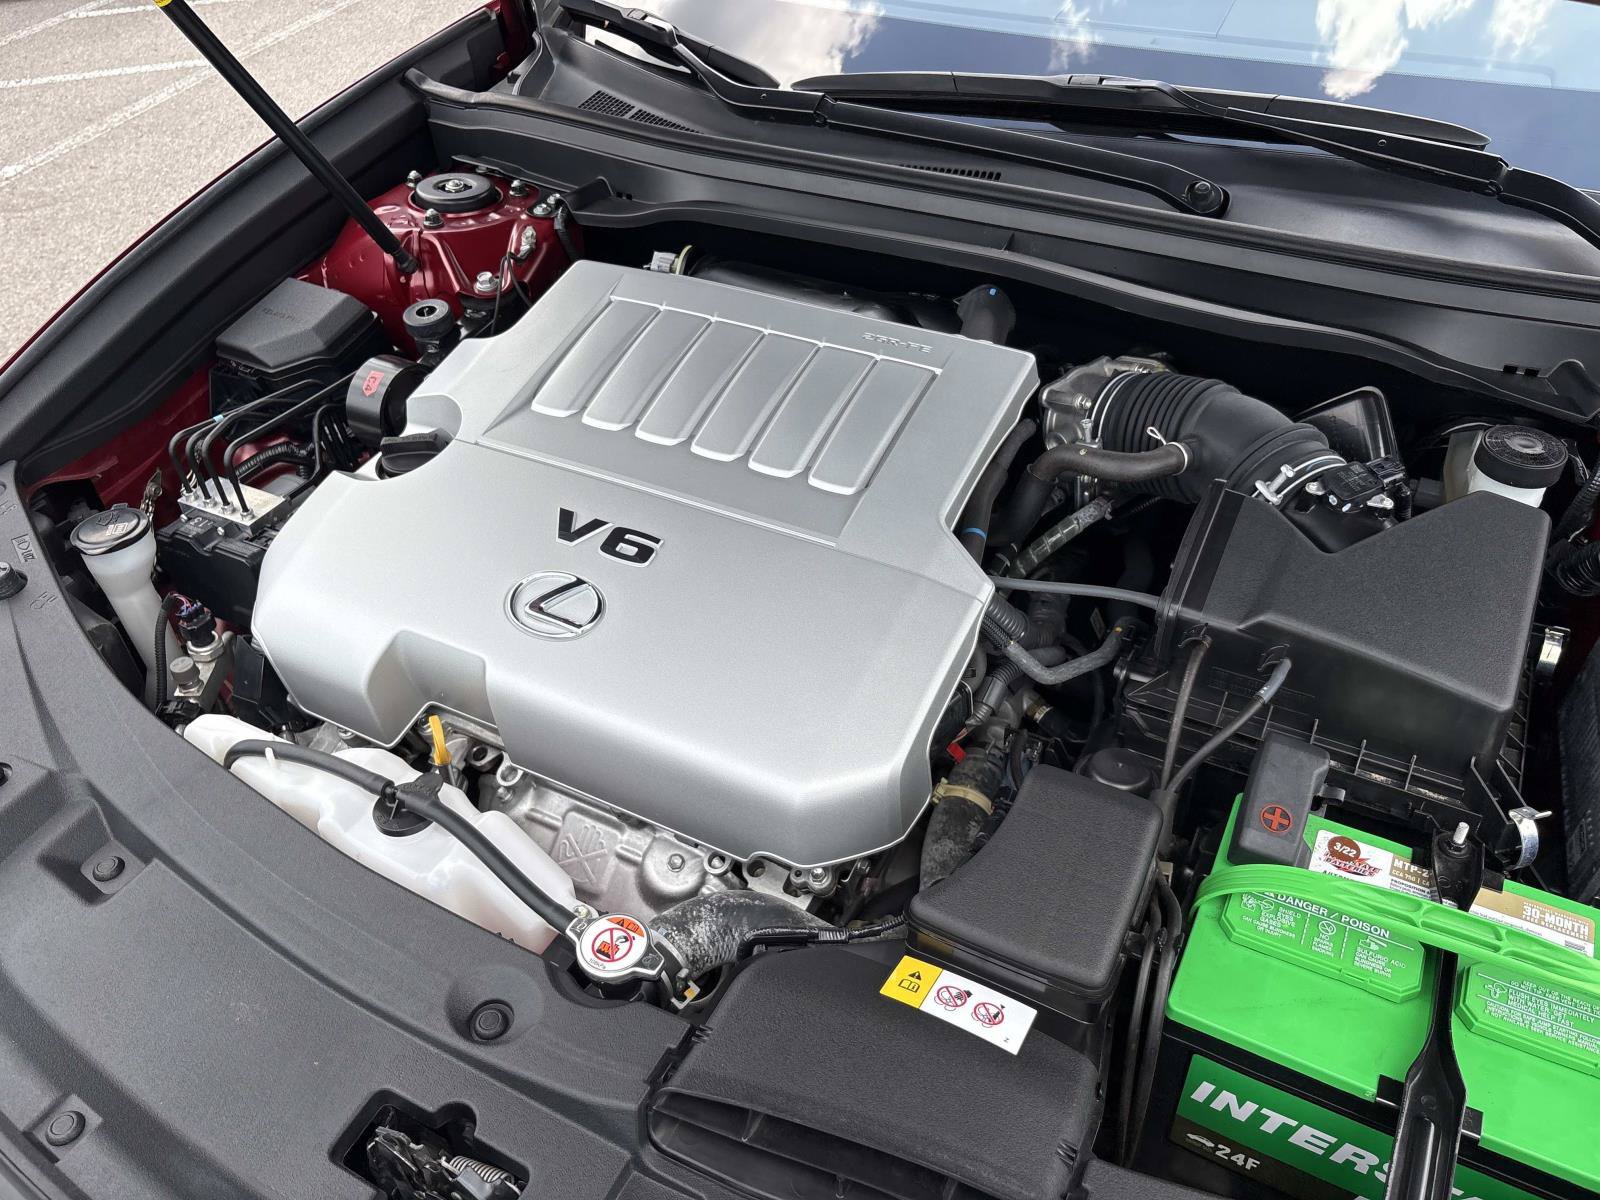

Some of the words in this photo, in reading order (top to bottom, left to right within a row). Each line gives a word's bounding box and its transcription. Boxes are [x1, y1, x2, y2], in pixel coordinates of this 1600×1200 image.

[556, 507, 664, 567] V6
[1333, 842, 1357, 858] 3/22
[1277, 893, 1328, 916] DANGER
[1341, 914, 1390, 938] POISON
[1522, 905, 1589, 936] 30-MONTH
[1390, 959, 1405, 969] ACID
[1507, 998, 1535, 1014] MEDICAL
[1537, 1010, 1554, 1021] HELP
[1557, 1016, 1574, 1027] FAST
[1508, 987, 1529, 1000] FLUSH
[1531, 996, 1548, 1007] EYES
[1550, 1002, 1594, 1024] IMMEDIATELY
[1508, 993, 1524, 1004] WITH
[1553, 1009, 1566, 1019] GET
[1213, 1143, 1261, 1173] 24F
